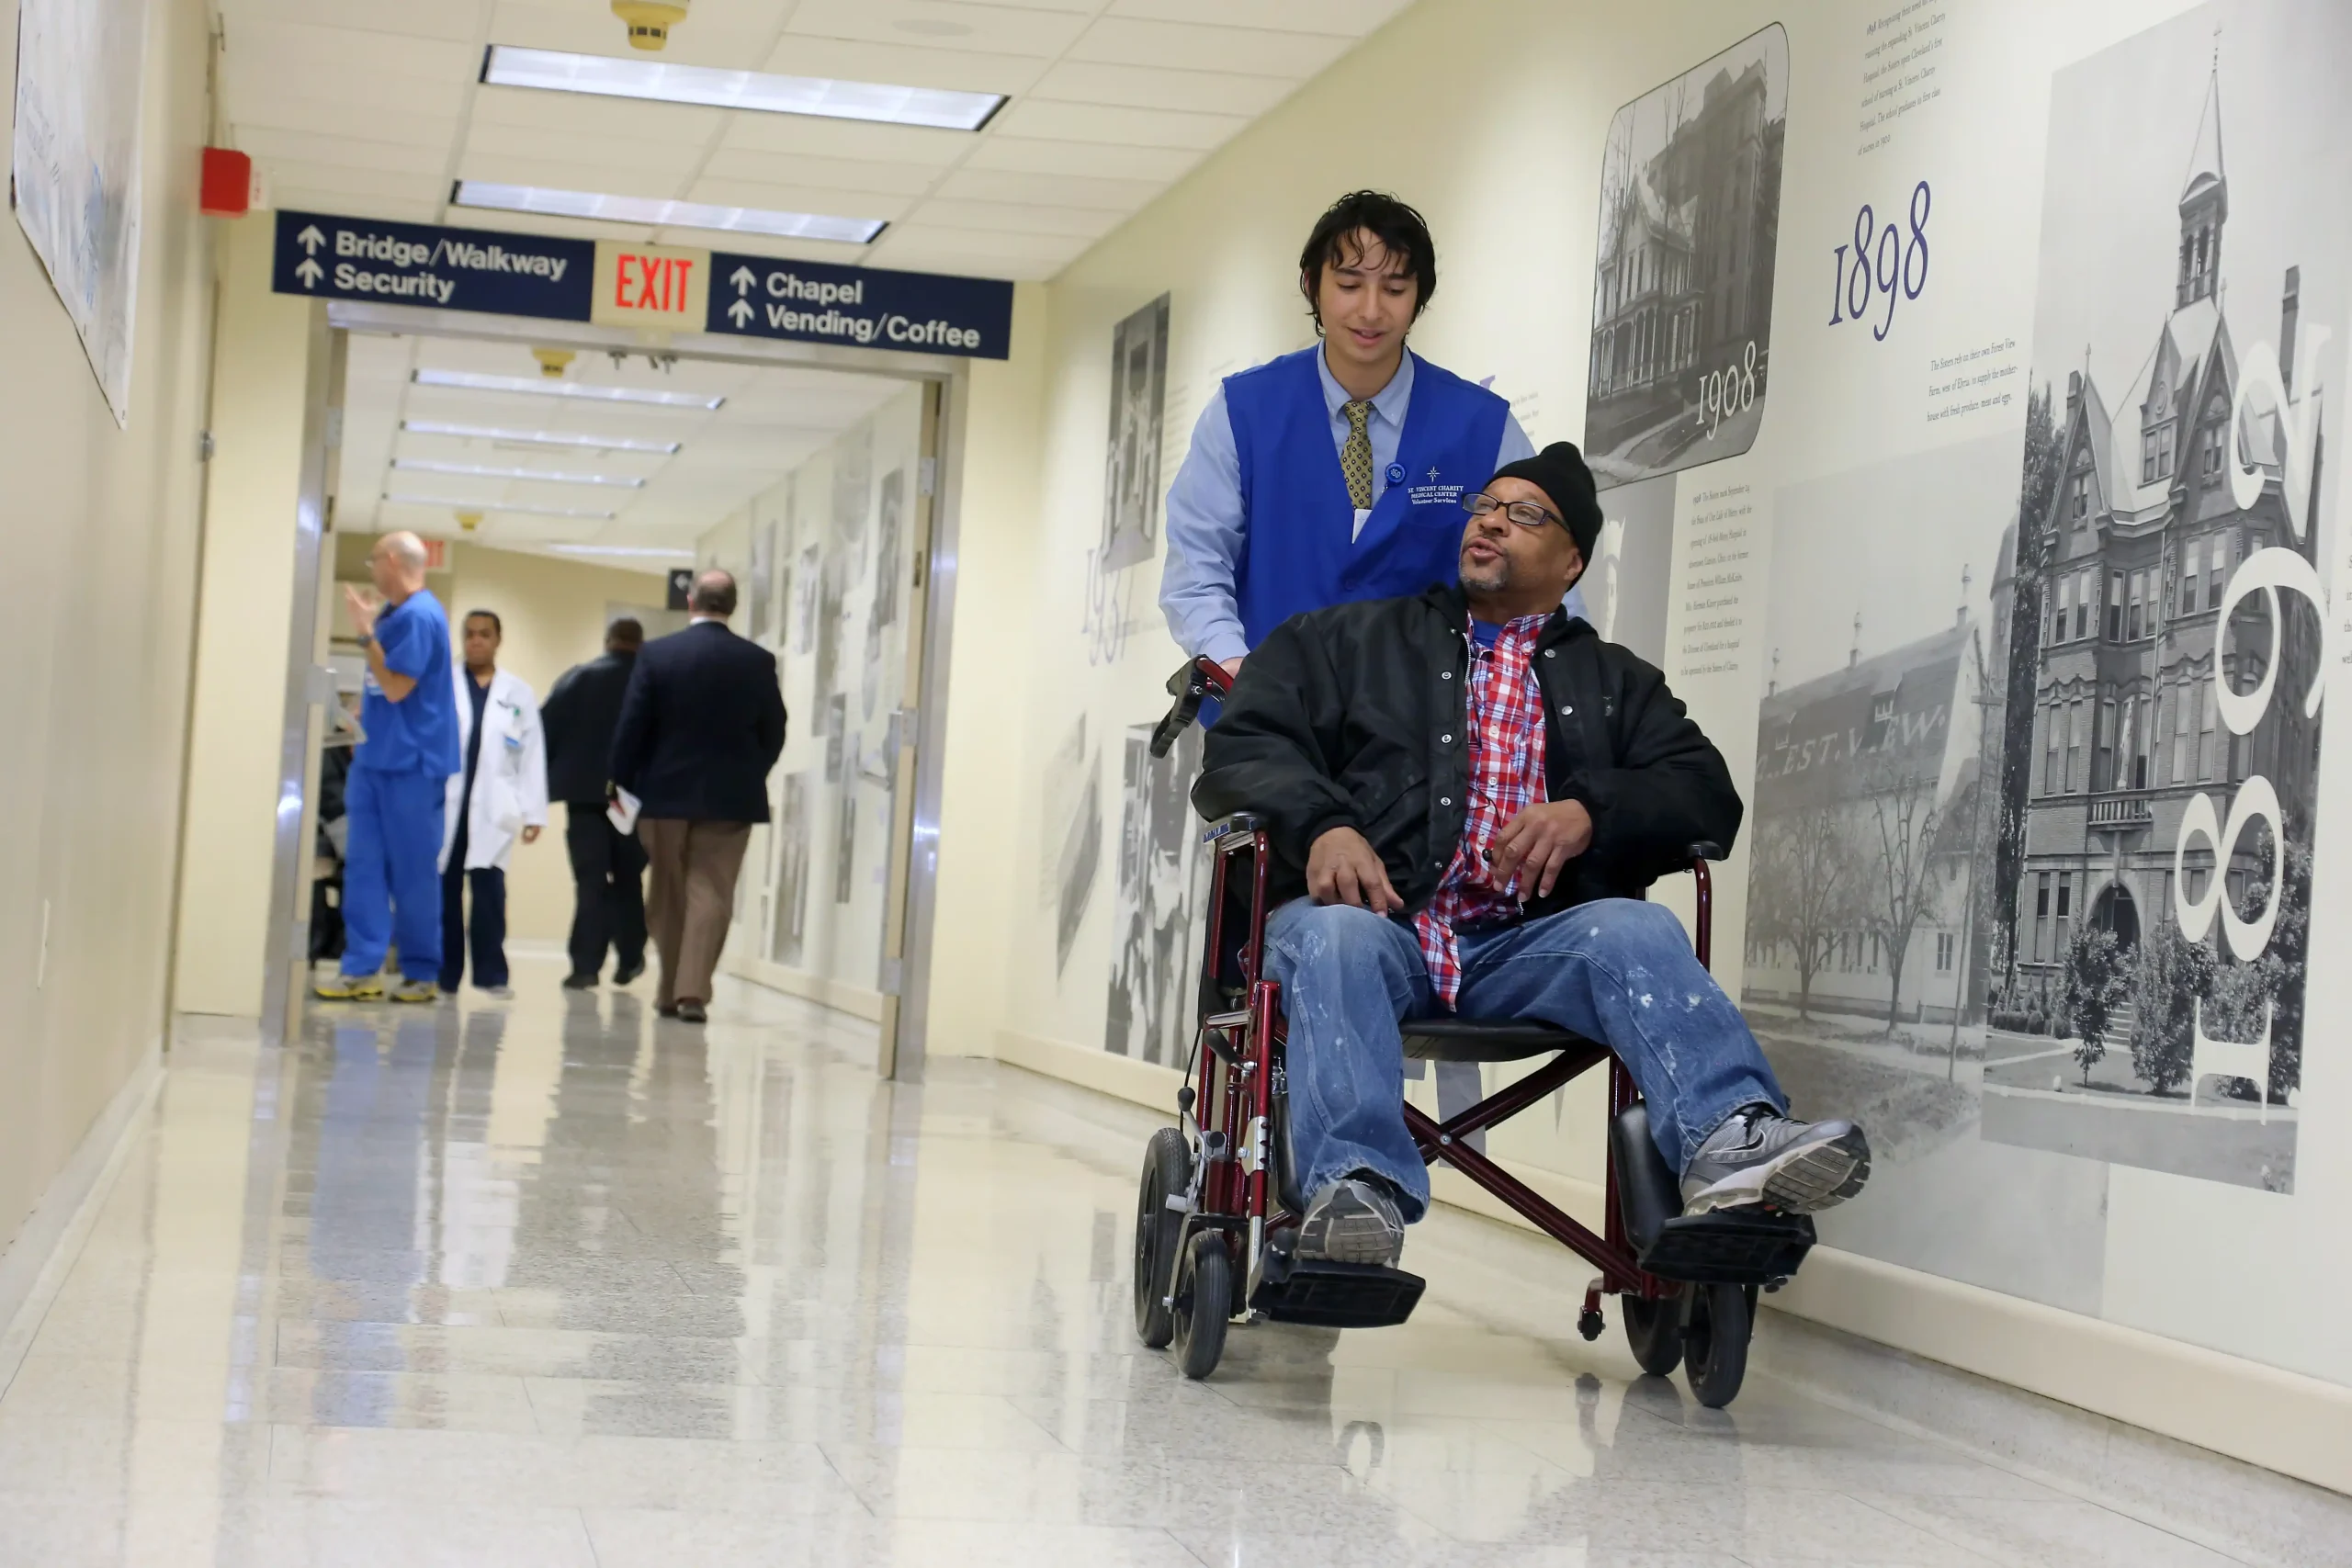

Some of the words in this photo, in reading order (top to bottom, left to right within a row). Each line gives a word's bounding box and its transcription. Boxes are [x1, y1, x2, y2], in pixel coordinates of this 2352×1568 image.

[335, 230, 568, 281] Bridge/Walkway
[1828, 180, 1931, 342] 1898
[334, 263, 456, 303] Security
[614, 253, 693, 314] EXIT
[766, 272, 863, 307] Chapel
[766, 302, 980, 349] Vending/Coffee
[1930, 359, 1939, 371] The
[1939, 356, 1953, 369] Sisters
[1981, 347, 1990, 356] own
[1990, 342, 2005, 355] Forest
[2005, 338, 2016, 349] View
[1696, 340, 1757, 441] 1908
[1942, 383, 1951, 393] west
[1951, 378, 1957, 391] of
[1927, 411, 1939, 423] house
[1940, 406, 1950, 419] with
[1950, 402, 1961, 416] fresh
[1981, 397, 1992, 408] meat
[1992, 391, 2001, 404] and
[1411, 491, 1434, 500] MEDICAL
